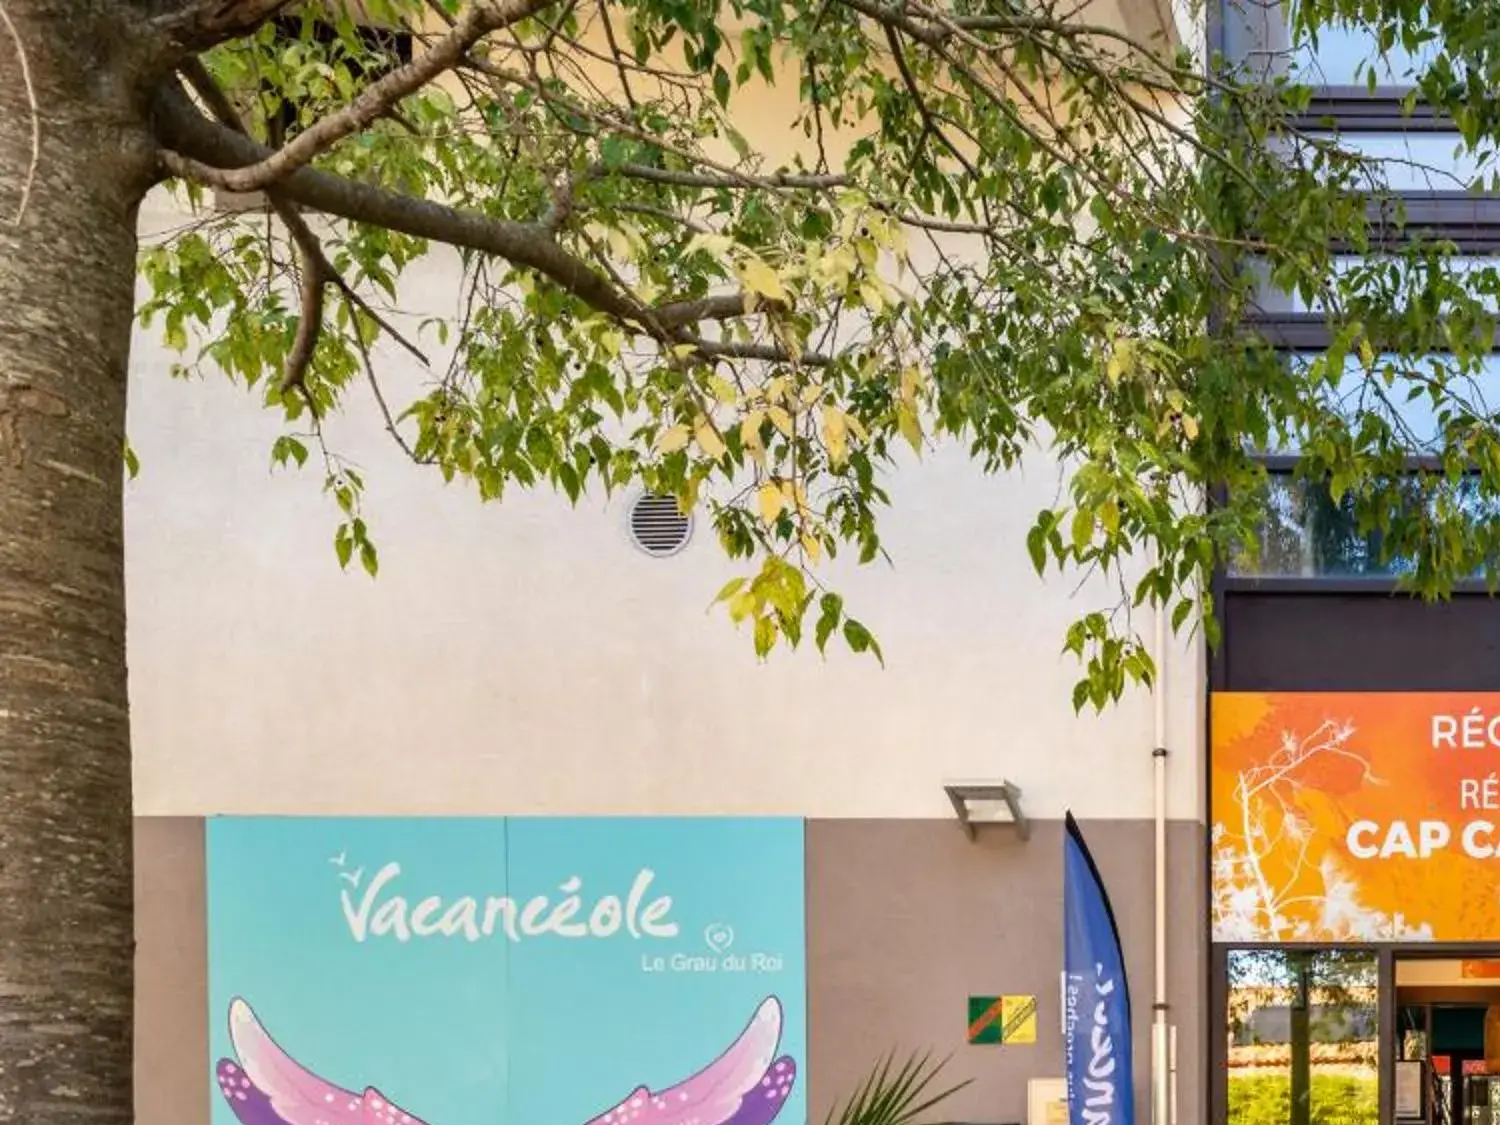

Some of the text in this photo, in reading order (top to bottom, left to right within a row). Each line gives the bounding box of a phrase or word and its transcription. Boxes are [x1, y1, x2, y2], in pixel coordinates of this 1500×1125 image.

[1346, 819, 1450, 859] CAP
[341, 861, 680, 943] Vacancéole
[641, 952, 783, 972] Le Grau du Roi
